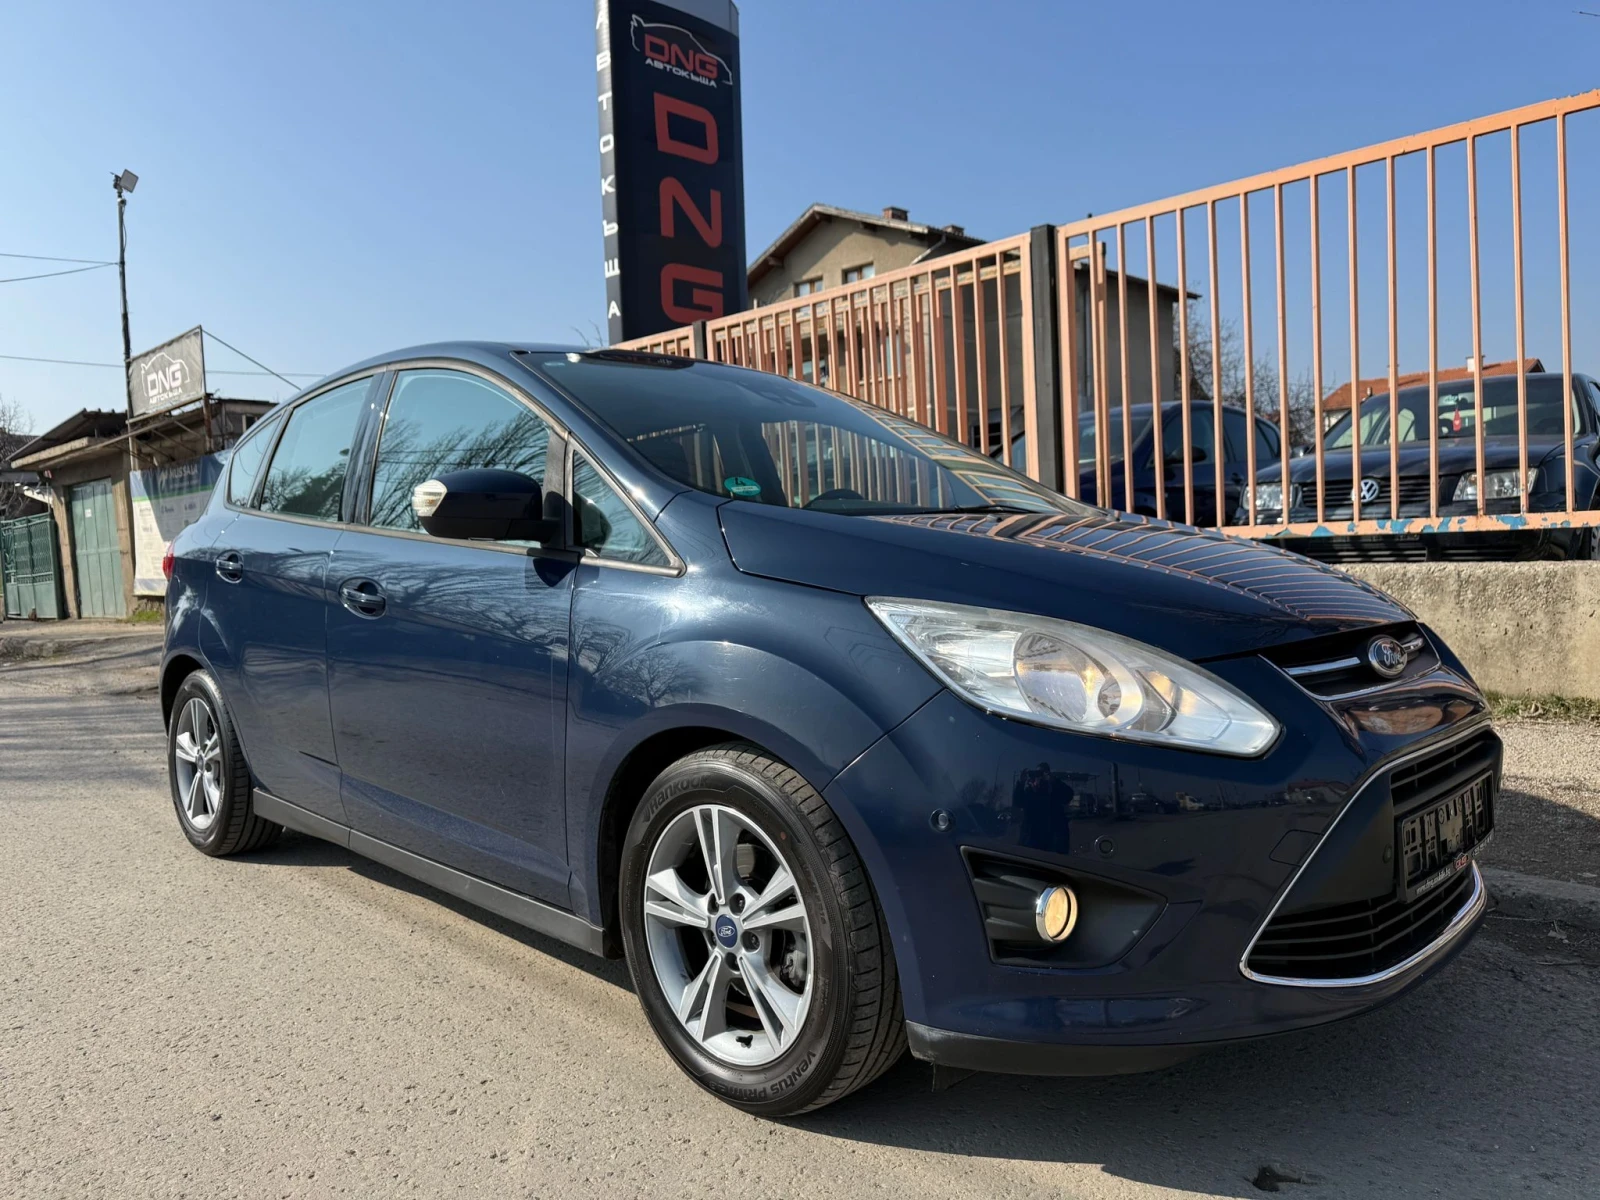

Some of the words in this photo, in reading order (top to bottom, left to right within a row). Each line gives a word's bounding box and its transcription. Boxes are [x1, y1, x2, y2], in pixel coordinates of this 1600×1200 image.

[644, 33, 718, 80] DNG
[653, 91, 724, 325] DNG
[146, 362, 182, 397] DNG
